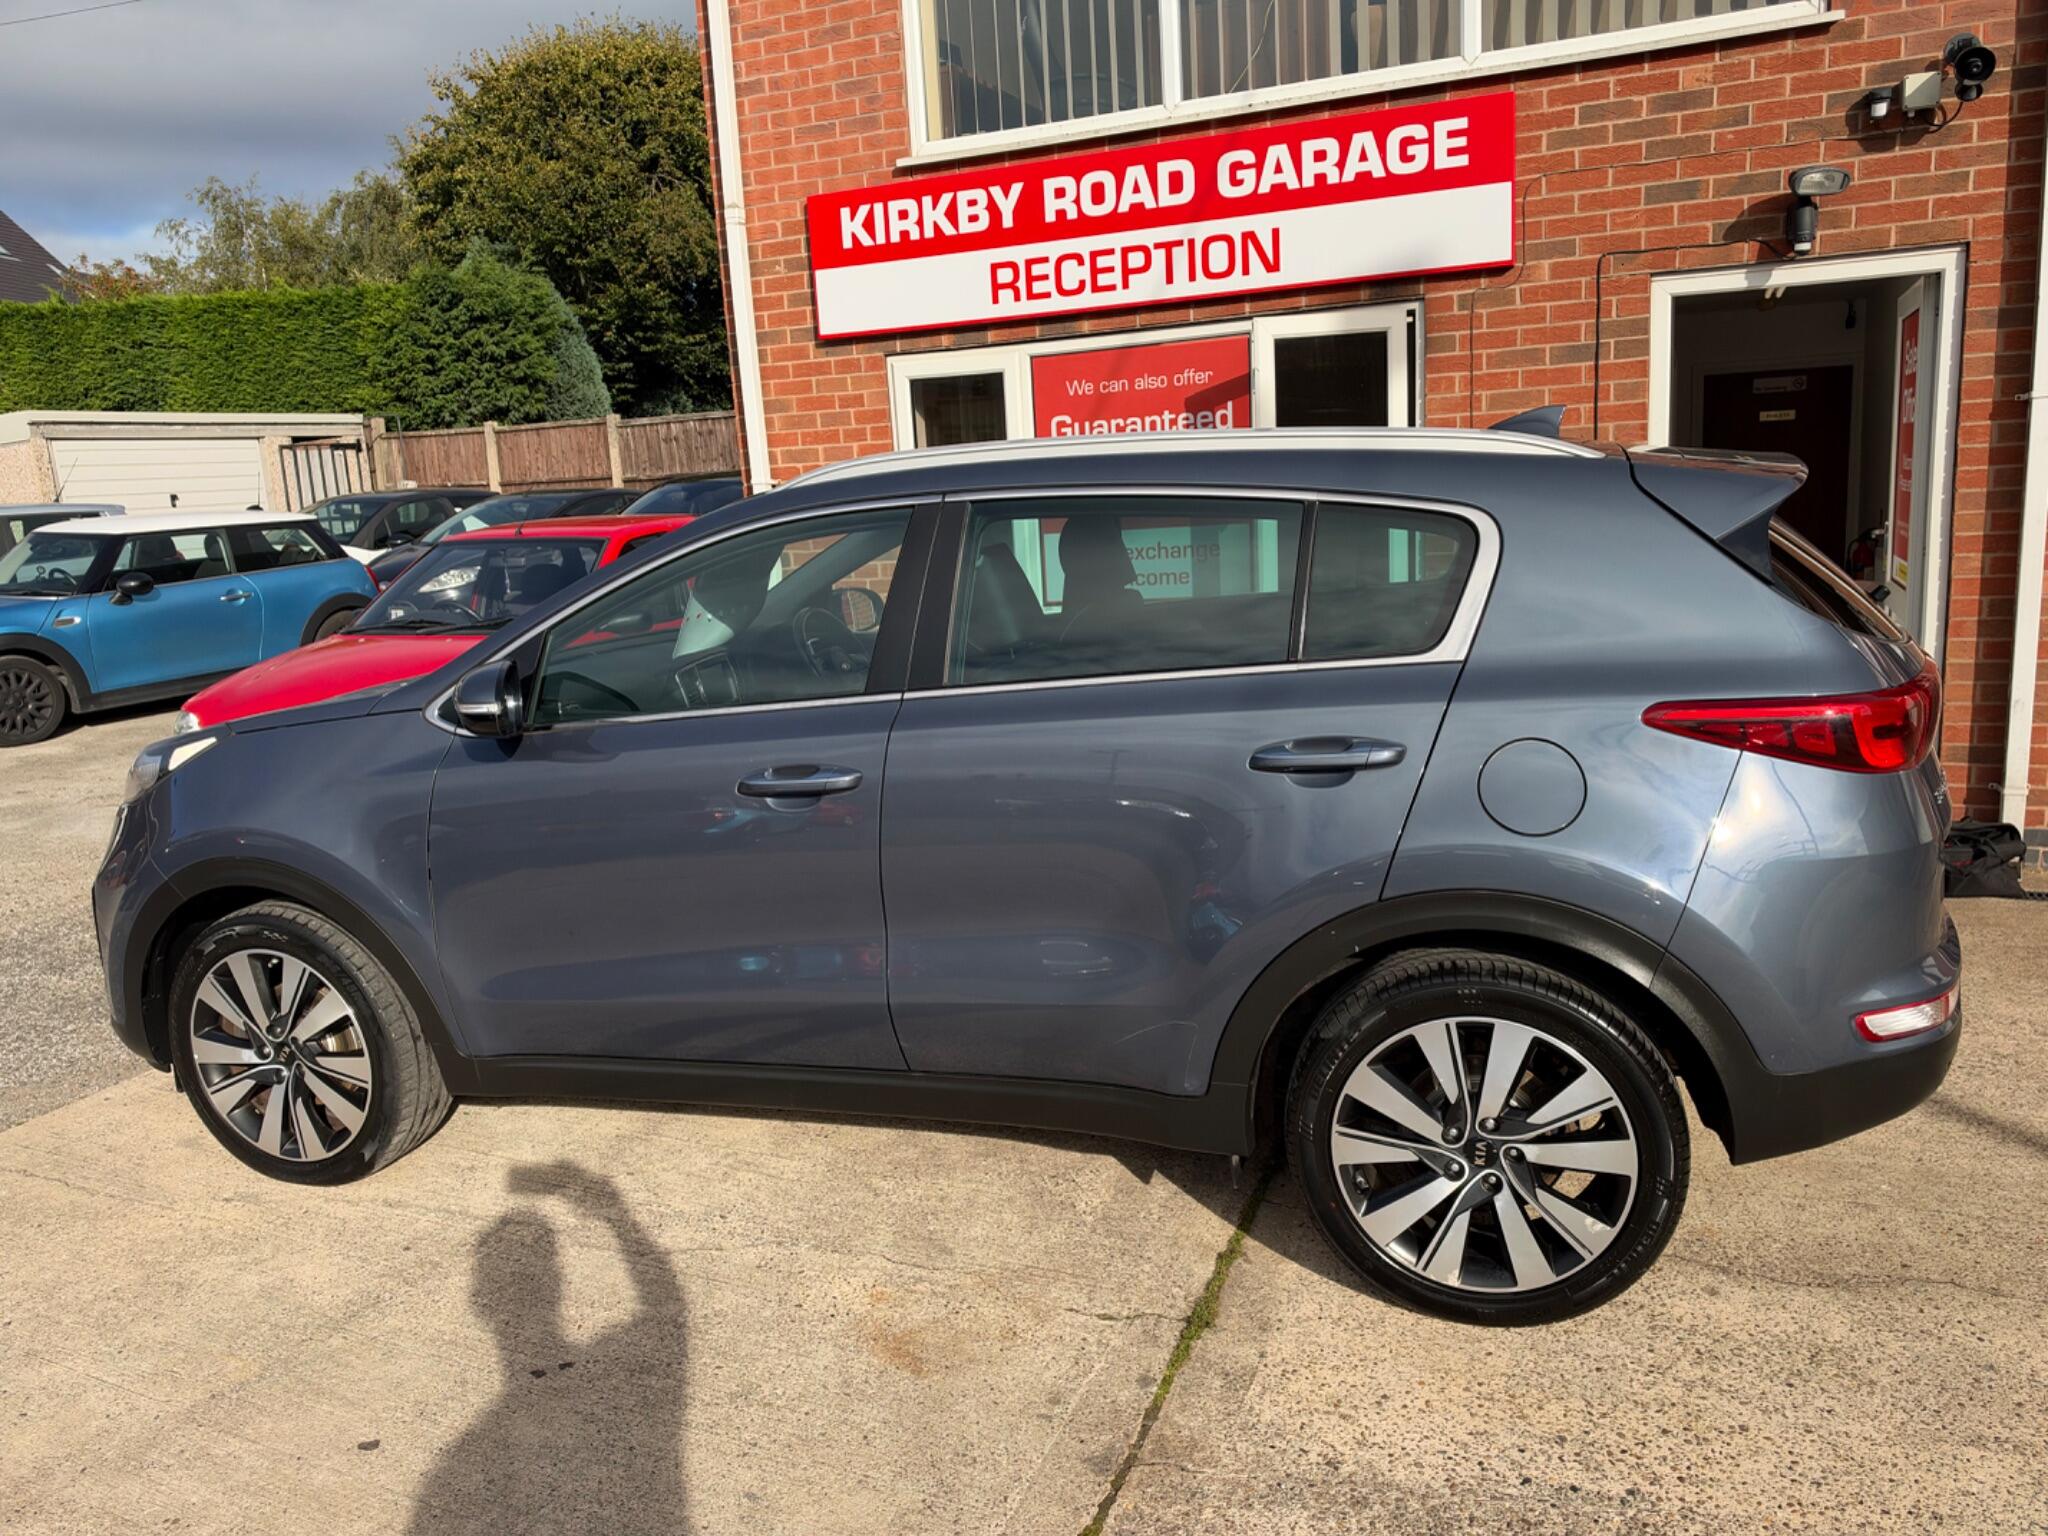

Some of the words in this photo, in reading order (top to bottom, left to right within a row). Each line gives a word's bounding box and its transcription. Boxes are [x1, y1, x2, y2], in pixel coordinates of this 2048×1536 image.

[839, 182, 1024, 250] KIRKBY
[1043, 159, 1196, 224] ROAD
[1217, 116, 1470, 199] GARAGE
[989, 228, 1281, 305] RECEPTION
[1066, 379, 1094, 396] We
[1099, 378, 1129, 393] can
[1134, 373, 1168, 390] also
[1173, 369, 1213, 386] offer
[1051, 401, 1233, 438] Guaranteed
[1132, 571, 1190, 586] come
[1474, 1141, 1487, 1166] KIA
